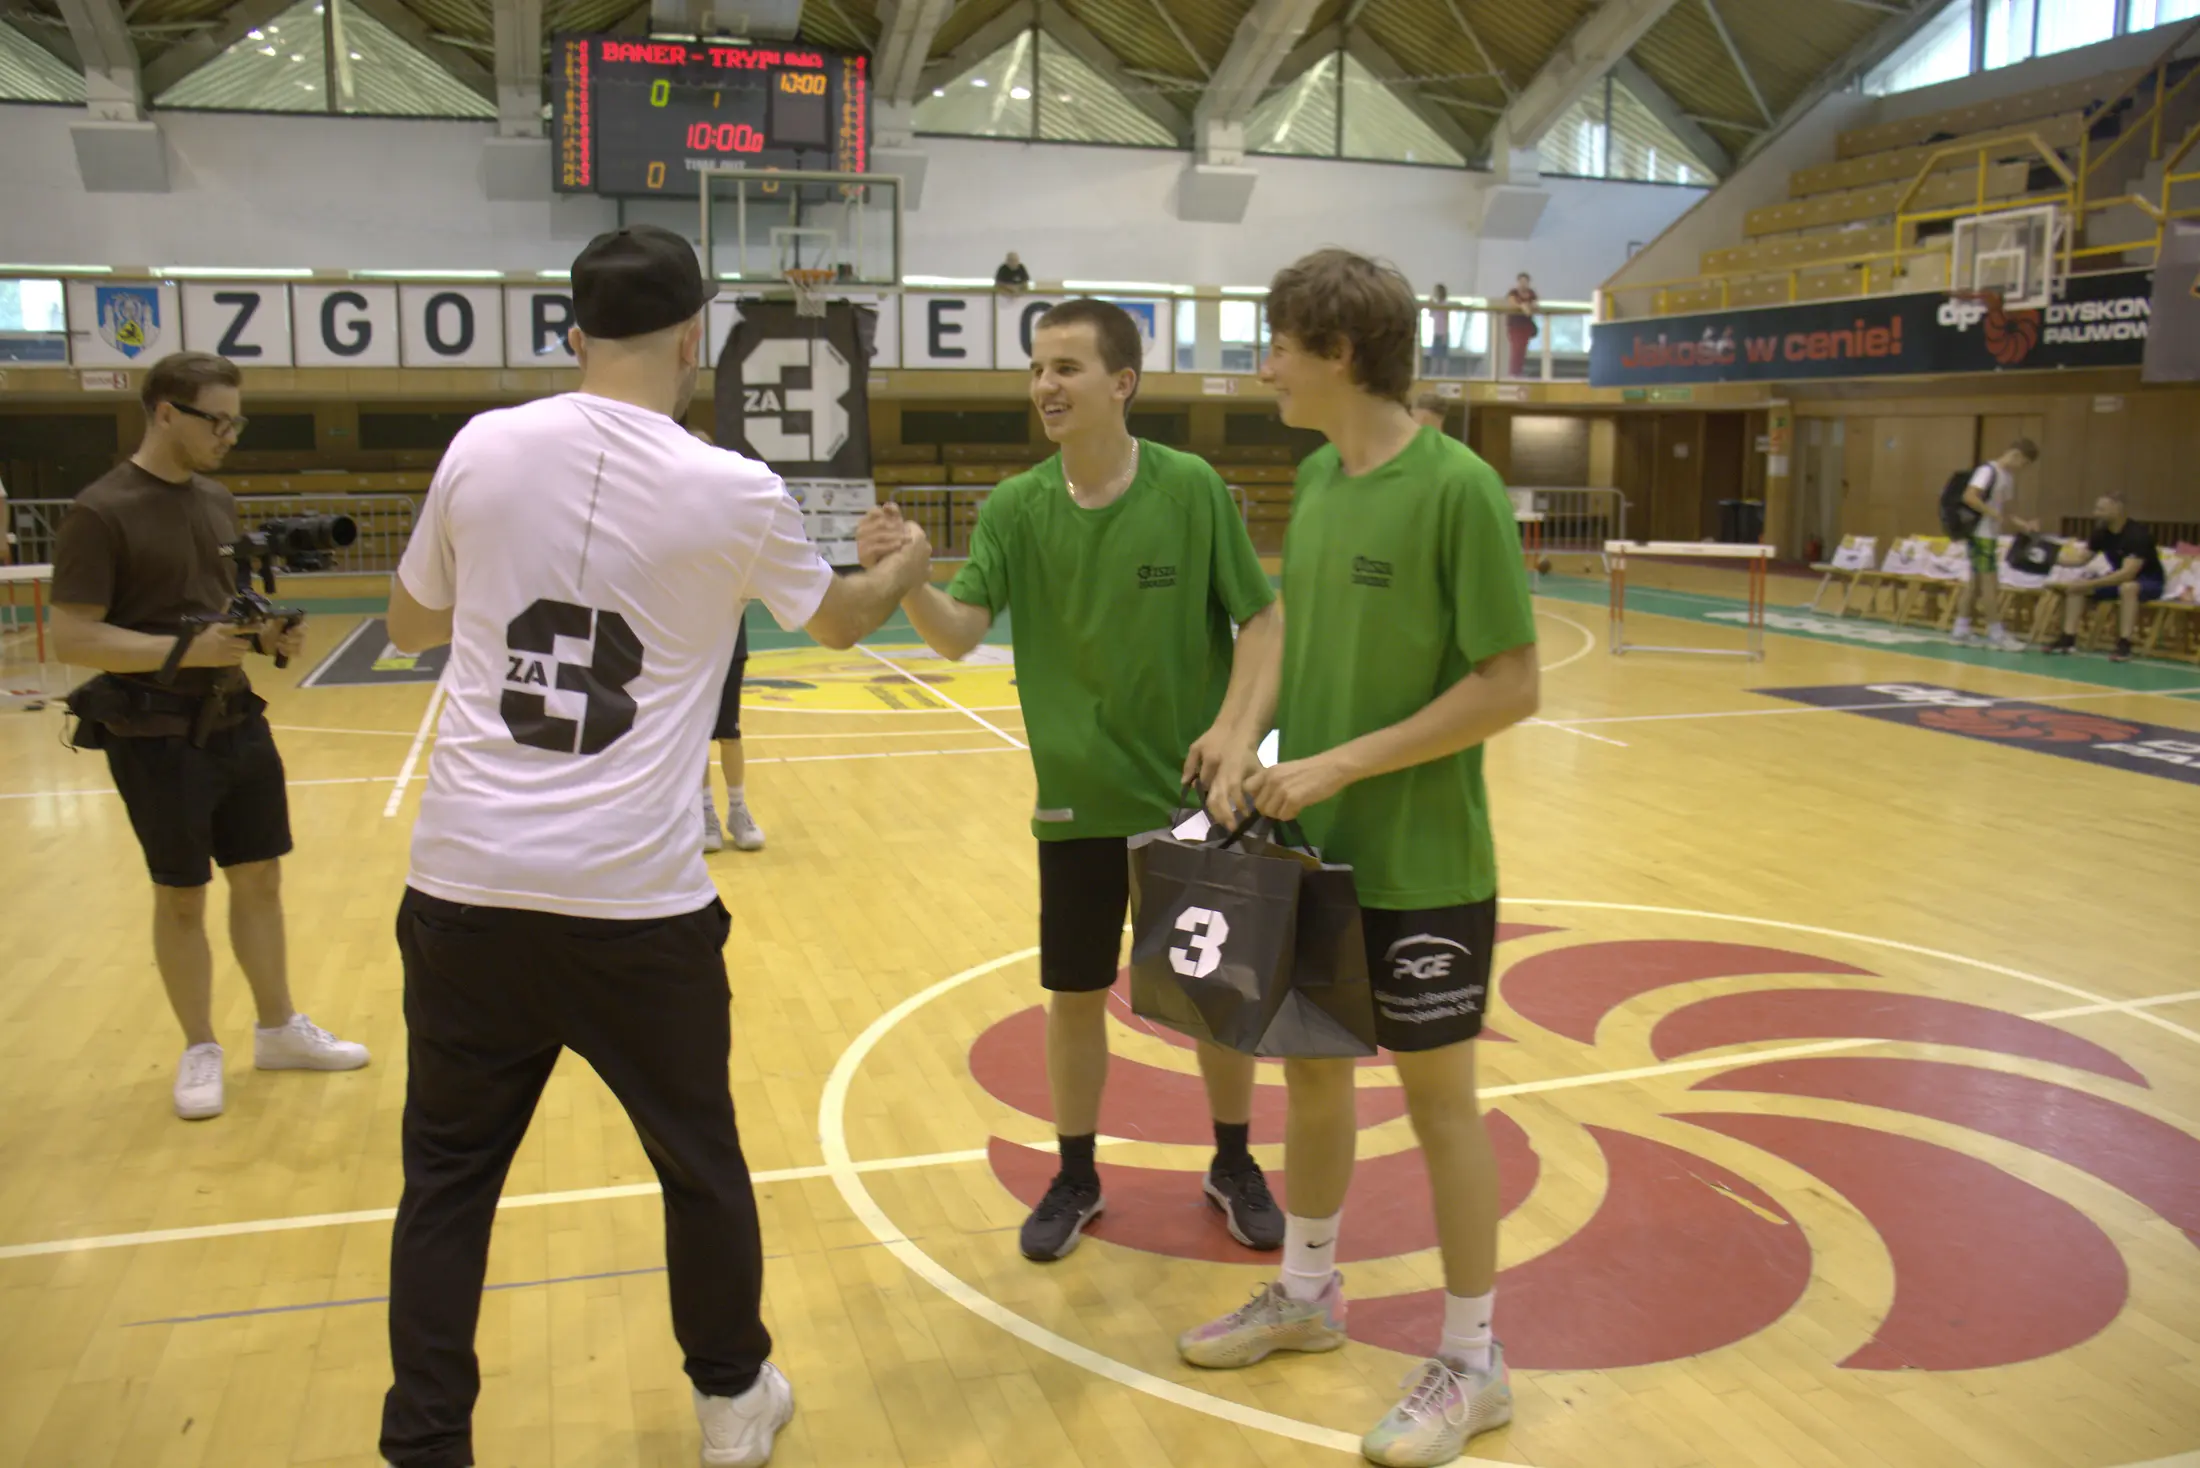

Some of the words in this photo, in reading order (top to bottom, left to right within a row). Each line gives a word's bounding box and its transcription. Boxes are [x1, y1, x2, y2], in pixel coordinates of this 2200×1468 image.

[651, 79, 670, 107] 0
[1744, 335, 1777, 363] w
[1783, 316, 1903, 362] cenie!
[741, 338, 850, 462] 3
[743, 388, 782, 412] ZA
[500, 598, 645, 756] 3
[506, 656, 549, 688] ZA
[1168, 905, 1230, 979] 3
